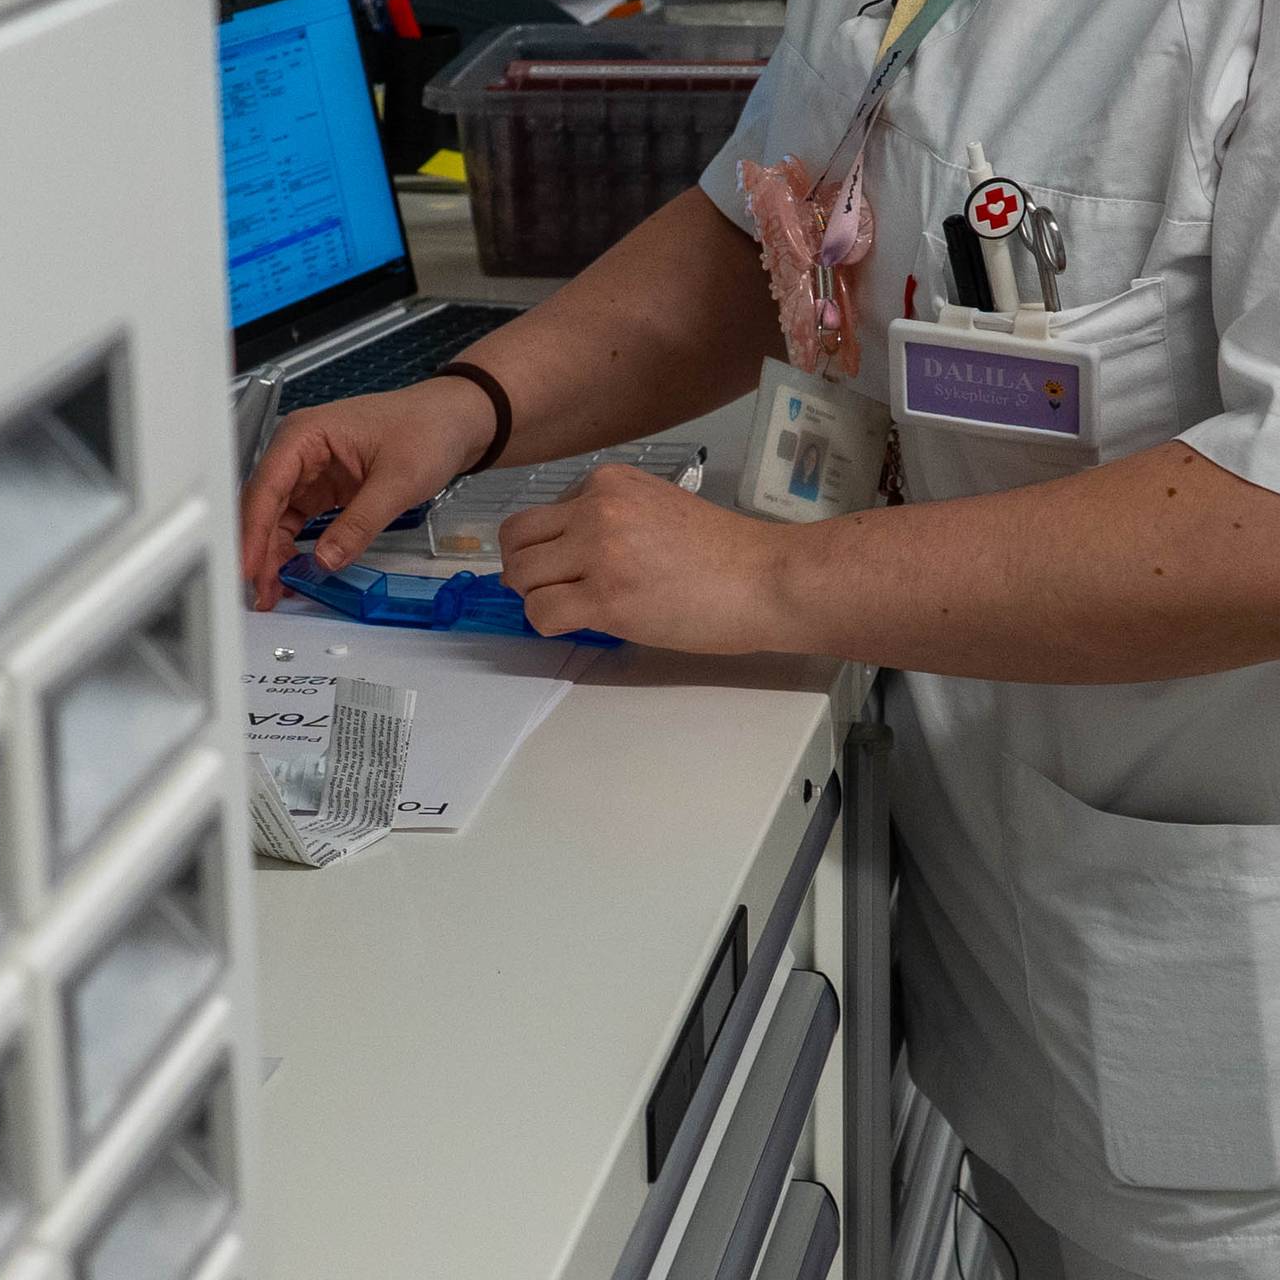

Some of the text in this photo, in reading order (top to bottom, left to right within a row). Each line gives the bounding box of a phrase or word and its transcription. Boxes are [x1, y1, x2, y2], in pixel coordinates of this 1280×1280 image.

[923, 357, 1037, 393] DALILA
[265, 687, 318, 695] Ordre
[248, 712, 330, 728] 76A
